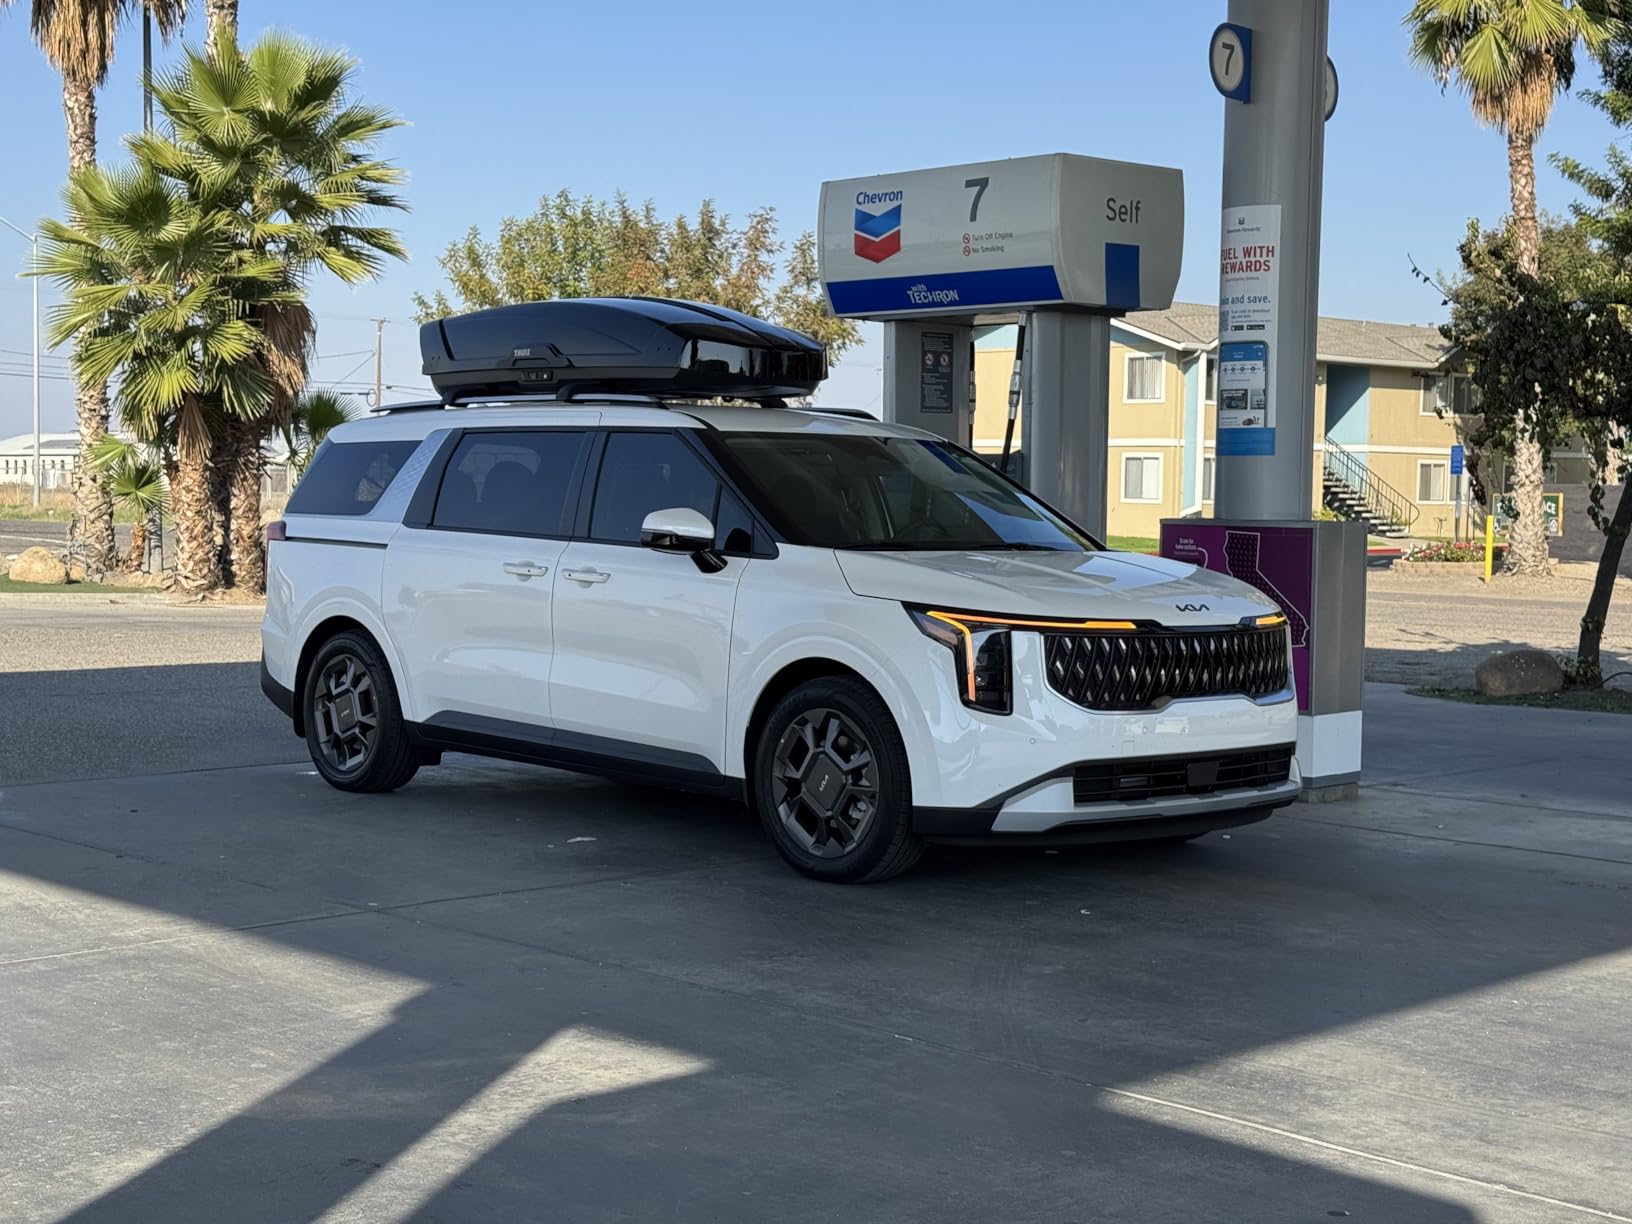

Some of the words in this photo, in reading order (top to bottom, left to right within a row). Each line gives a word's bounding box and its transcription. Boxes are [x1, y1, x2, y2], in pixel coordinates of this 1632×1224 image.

[1221, 41, 1236, 76] 7
[856, 190, 903, 206] Chevron
[964, 176, 990, 223] 7
[1105, 196, 1141, 225] Self
[994, 231, 1013, 240] Engine
[971, 246, 979, 254] No
[980, 244, 1005, 253] Smoking
[1242, 245, 1275, 259] WITH
[906, 289, 960, 304] TECHRON
[1230, 293, 1245, 305] and
[1246, 295, 1271, 304] save.
